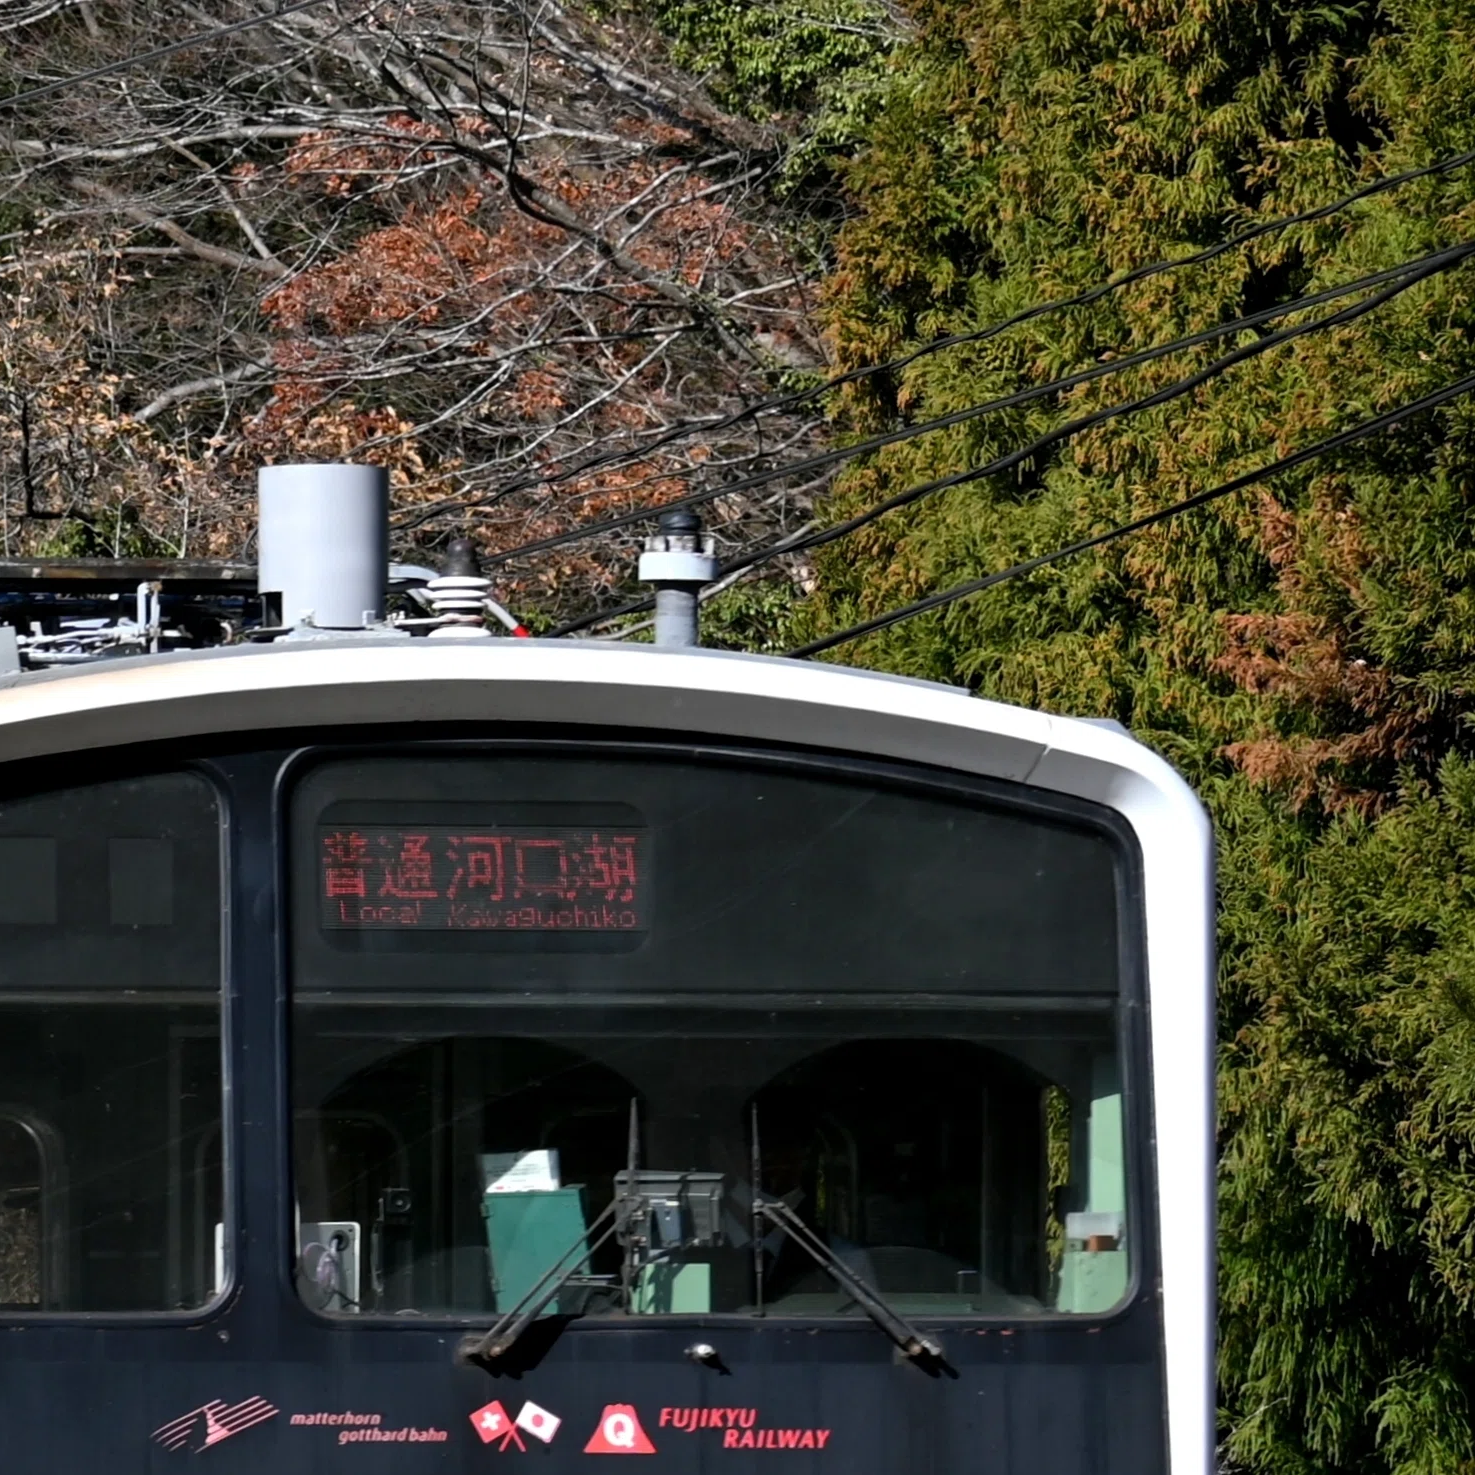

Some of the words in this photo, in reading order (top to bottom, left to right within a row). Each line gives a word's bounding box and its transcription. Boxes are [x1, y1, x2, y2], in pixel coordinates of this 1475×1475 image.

[339, 901, 422, 924] Local
[447, 904, 637, 928] Kawaguchiko
[290, 1411, 381, 1426] matterhorn
[658, 1407, 758, 1432] FUJIKYU
[338, 1427, 408, 1445] gotthard
[409, 1427, 447, 1442] bahn
[723, 1429, 831, 1449] RAILWAY
